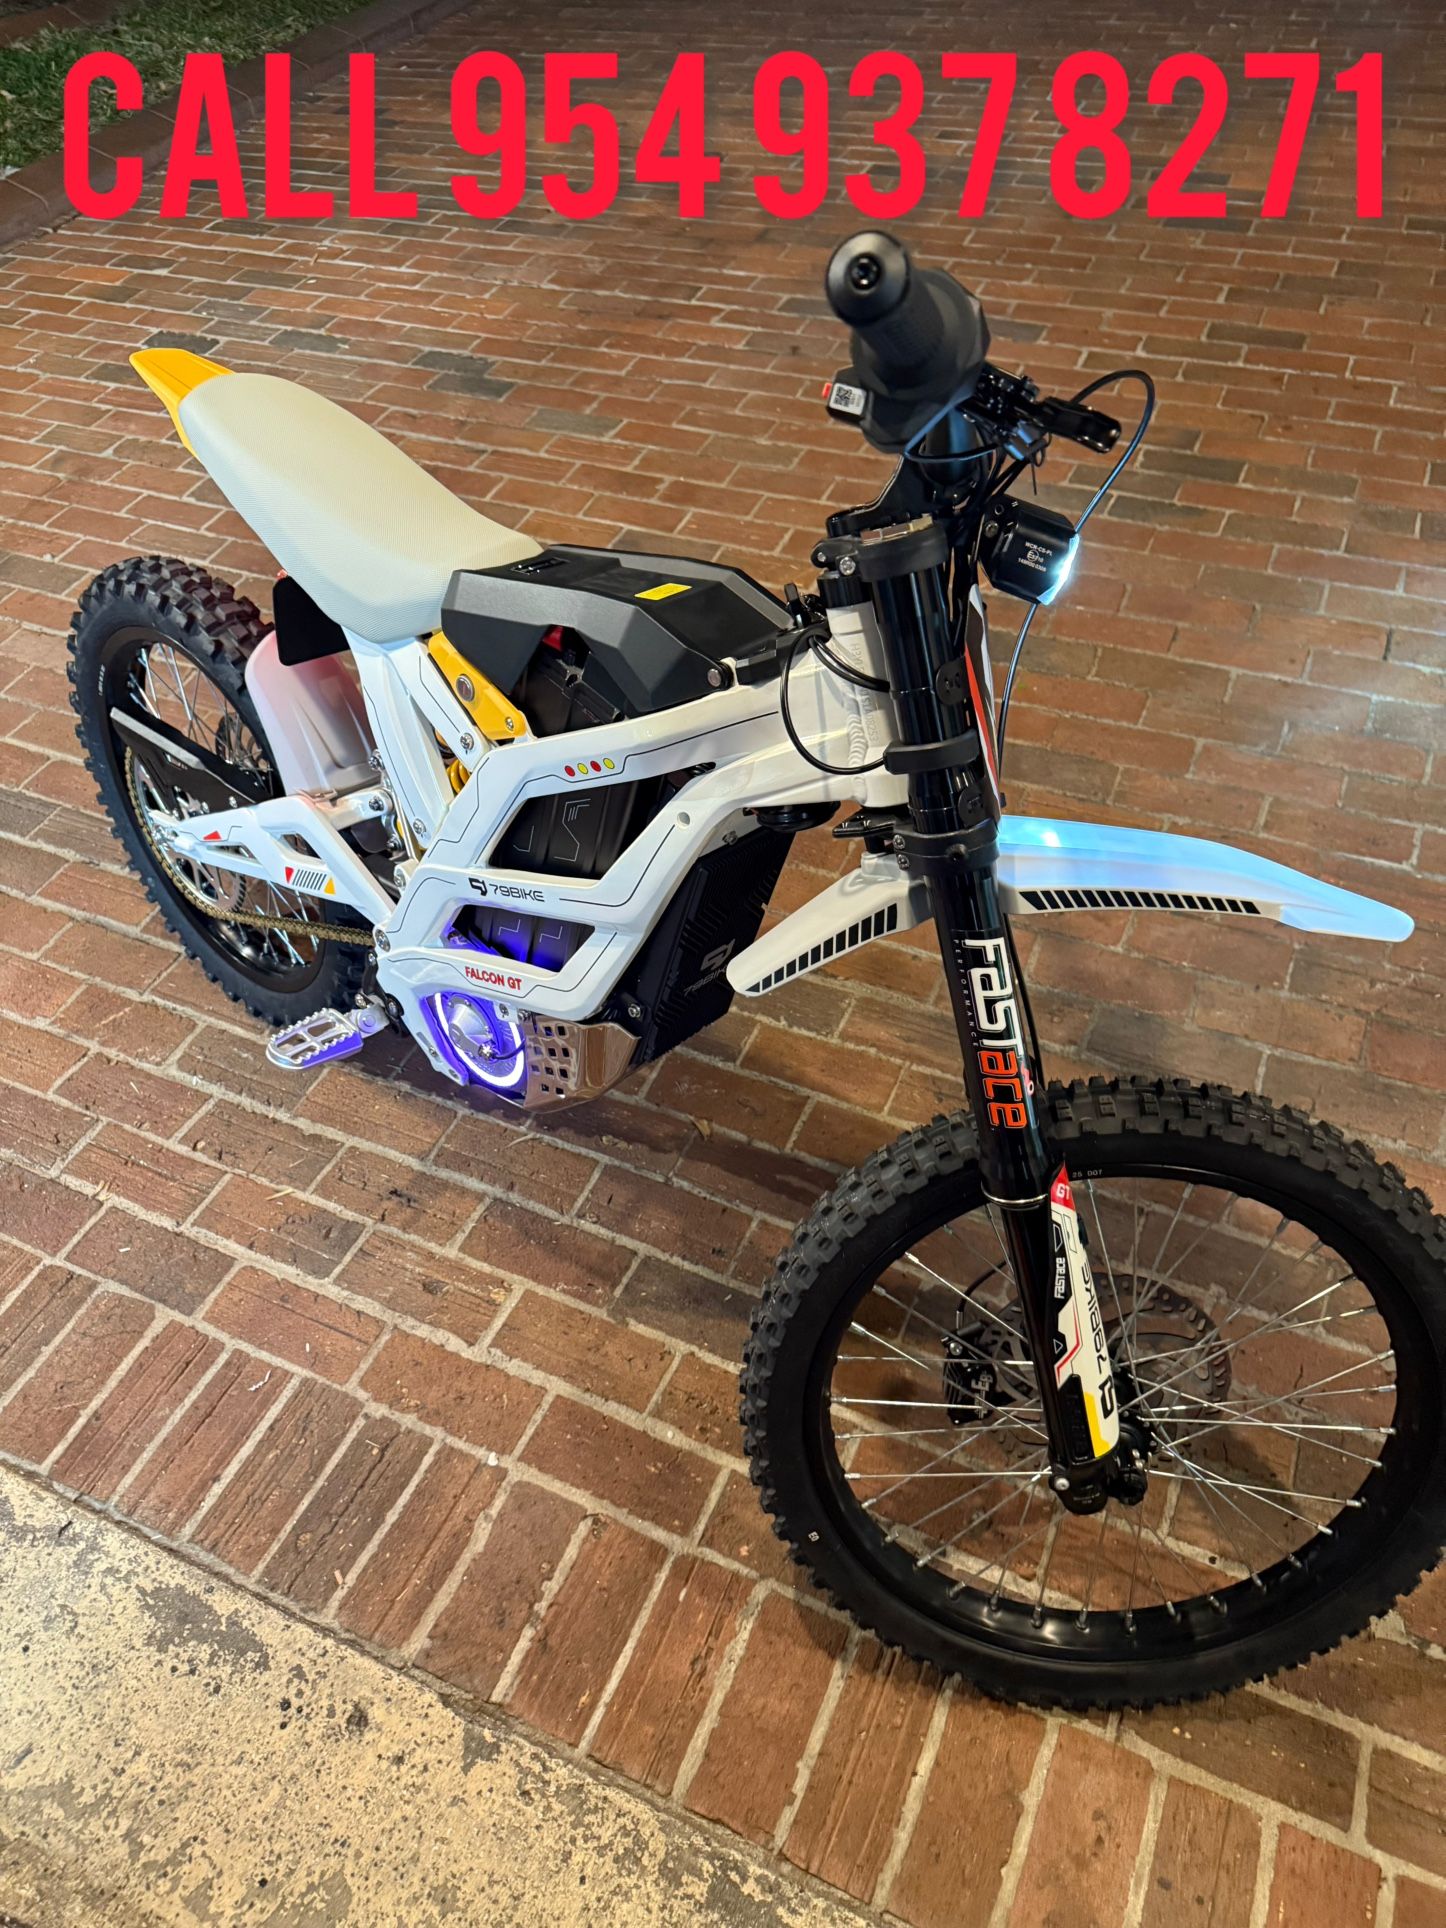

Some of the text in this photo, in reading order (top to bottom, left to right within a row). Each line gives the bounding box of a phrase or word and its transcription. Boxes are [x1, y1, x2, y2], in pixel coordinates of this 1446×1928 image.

[488, 883, 545, 902] 79BIKE
[464, 966, 522, 990] FALCON GT
[683, 964, 728, 997] 79BIK
[953, 939, 979, 1047] PERFORMANCE
[1056, 1183, 1071, 1200] GT
[1081, 1261, 1107, 1375] 79BIKE
